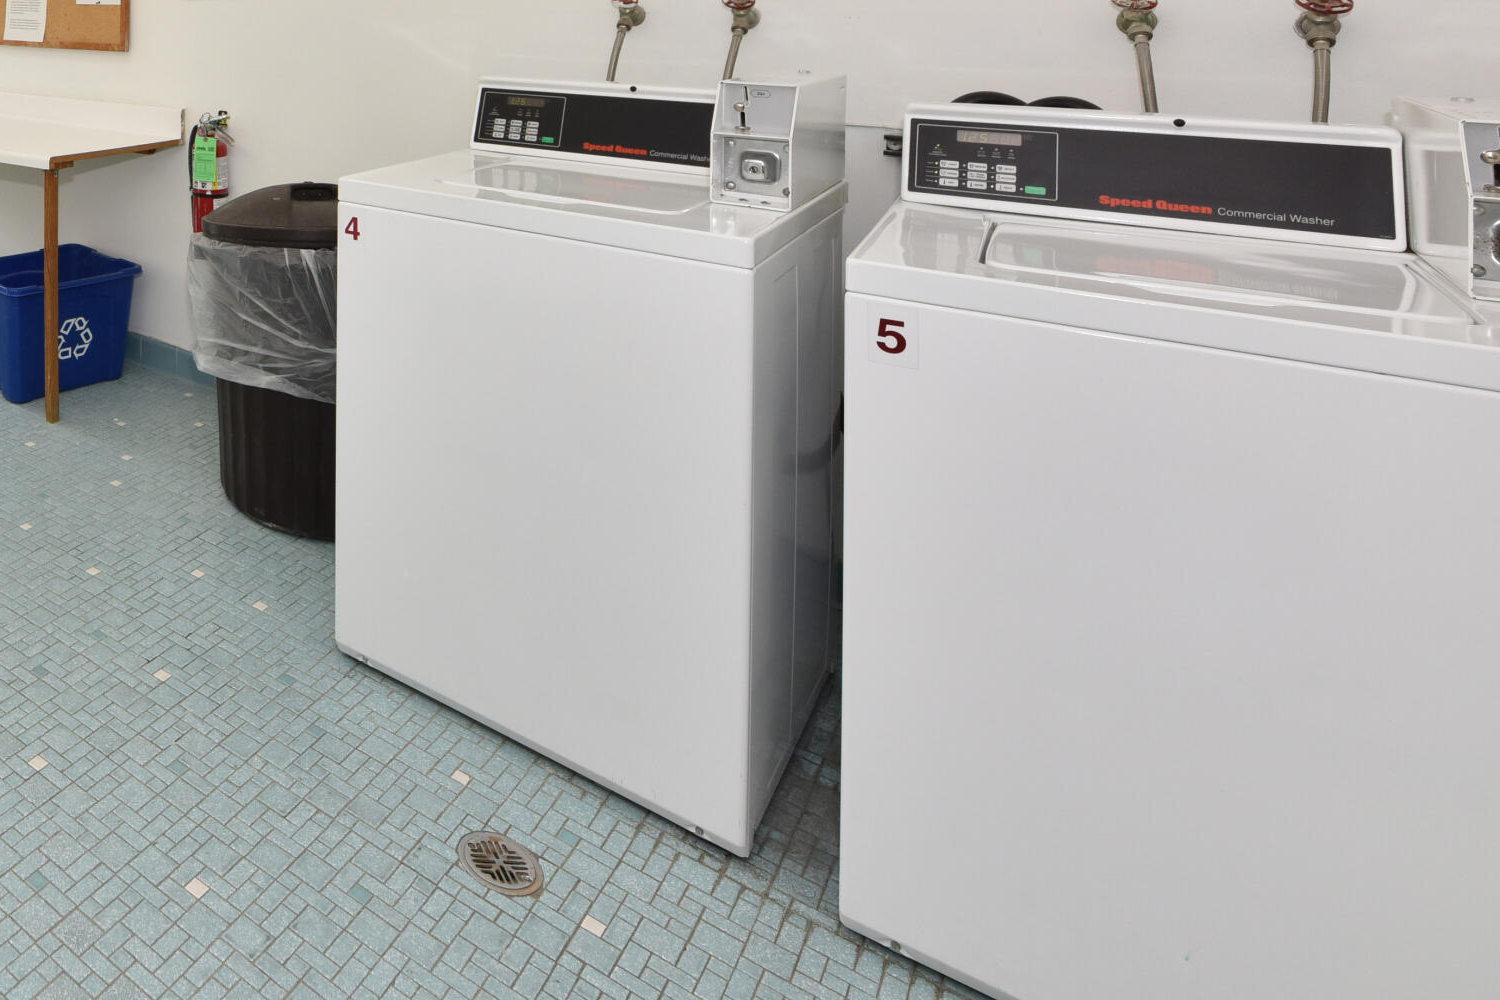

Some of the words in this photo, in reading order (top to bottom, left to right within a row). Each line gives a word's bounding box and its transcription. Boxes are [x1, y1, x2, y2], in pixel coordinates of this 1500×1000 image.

[582, 141, 614, 152] Speed
[615, 145, 648, 156] Queen
[649, 150, 688, 160] Commercial
[1099, 194, 1153, 209] Speed
[1155, 200, 1213, 215] Queen
[1217, 207, 1286, 222] Commercial
[1289, 214, 1335, 226] Washer
[345, 216, 360, 240] 4
[876, 318, 907, 354] 5
